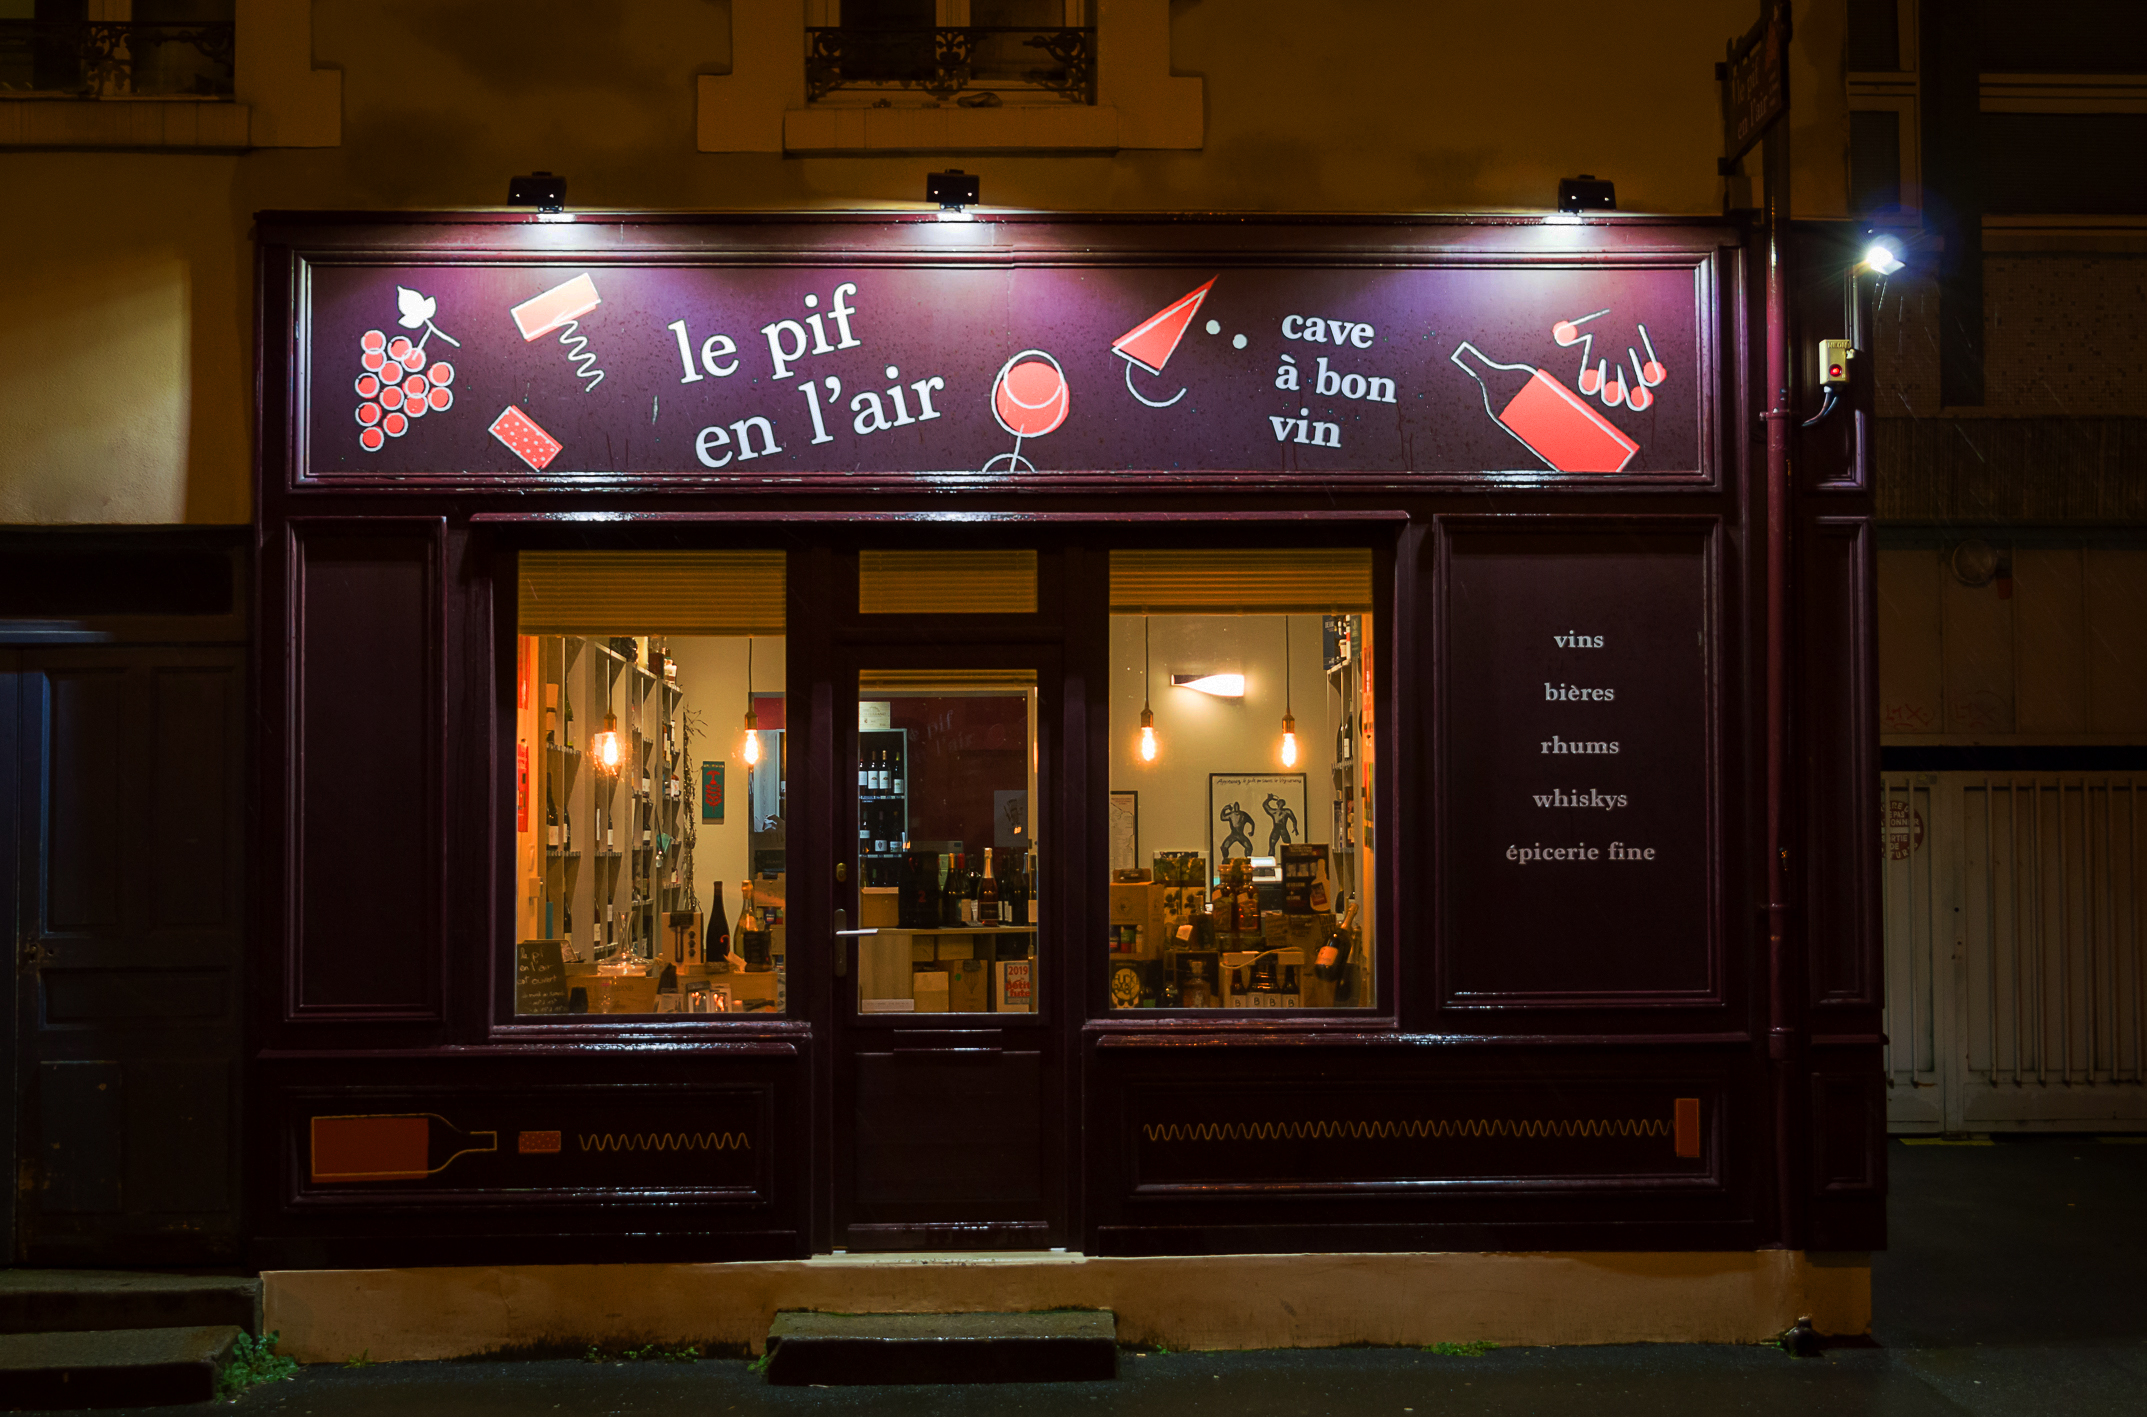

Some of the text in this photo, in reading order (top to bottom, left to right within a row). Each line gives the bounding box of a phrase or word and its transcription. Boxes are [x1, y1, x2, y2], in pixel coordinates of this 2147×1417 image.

[667, 282, 862, 384] le pif
[1281, 314, 1375, 348] cave
[1274, 353, 1397, 403] à bon
[695, 365, 945, 469] en l’air
[1268, 407, 1342, 448] vin
[1553, 630, 1604, 648] vins
[1544, 682, 1615, 701] bières
[1540, 735, 1620, 754] rhums
[1532, 788, 1628, 811] whiskys
[1505, 841, 1656, 865] épicerie fine
[1008, 966, 1029, 976] 2019
